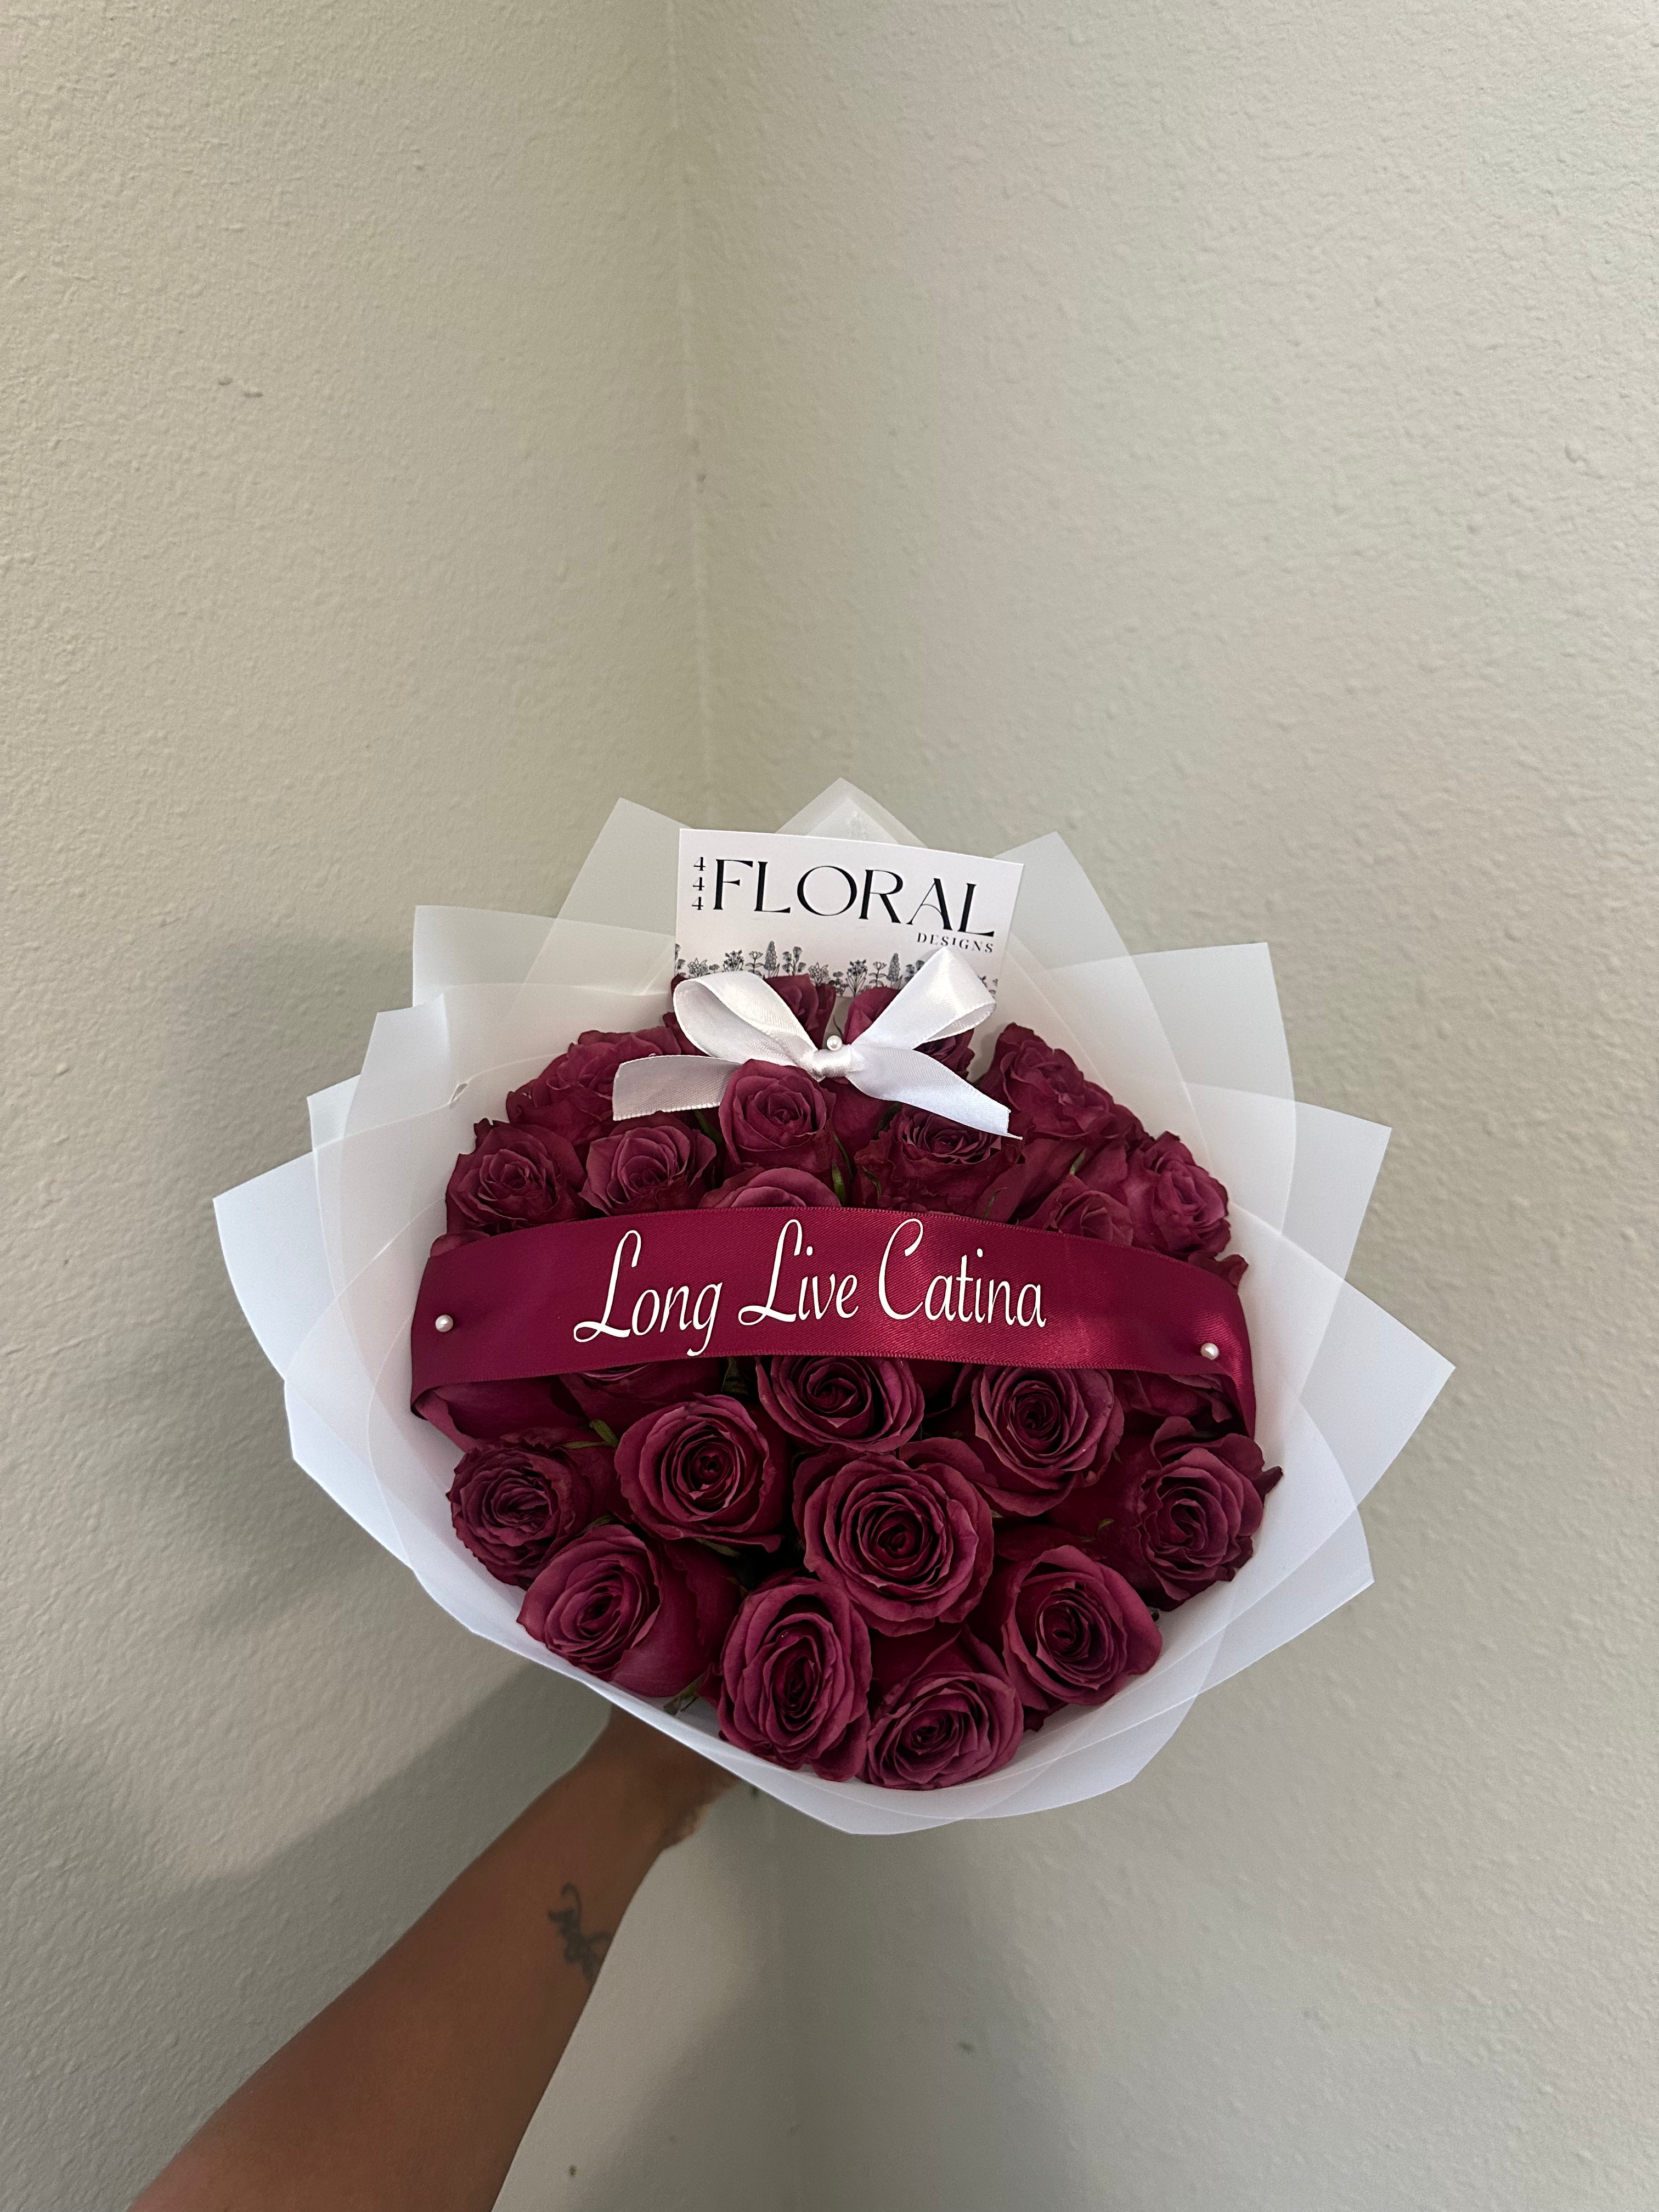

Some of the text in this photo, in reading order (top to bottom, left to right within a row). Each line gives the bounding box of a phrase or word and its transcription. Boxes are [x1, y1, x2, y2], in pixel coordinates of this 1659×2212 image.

[713, 859, 995, 937] FLORAL
[917, 932, 994, 953] DESIGNS
[573, 1217, 1047, 1357] Long Live Catina
